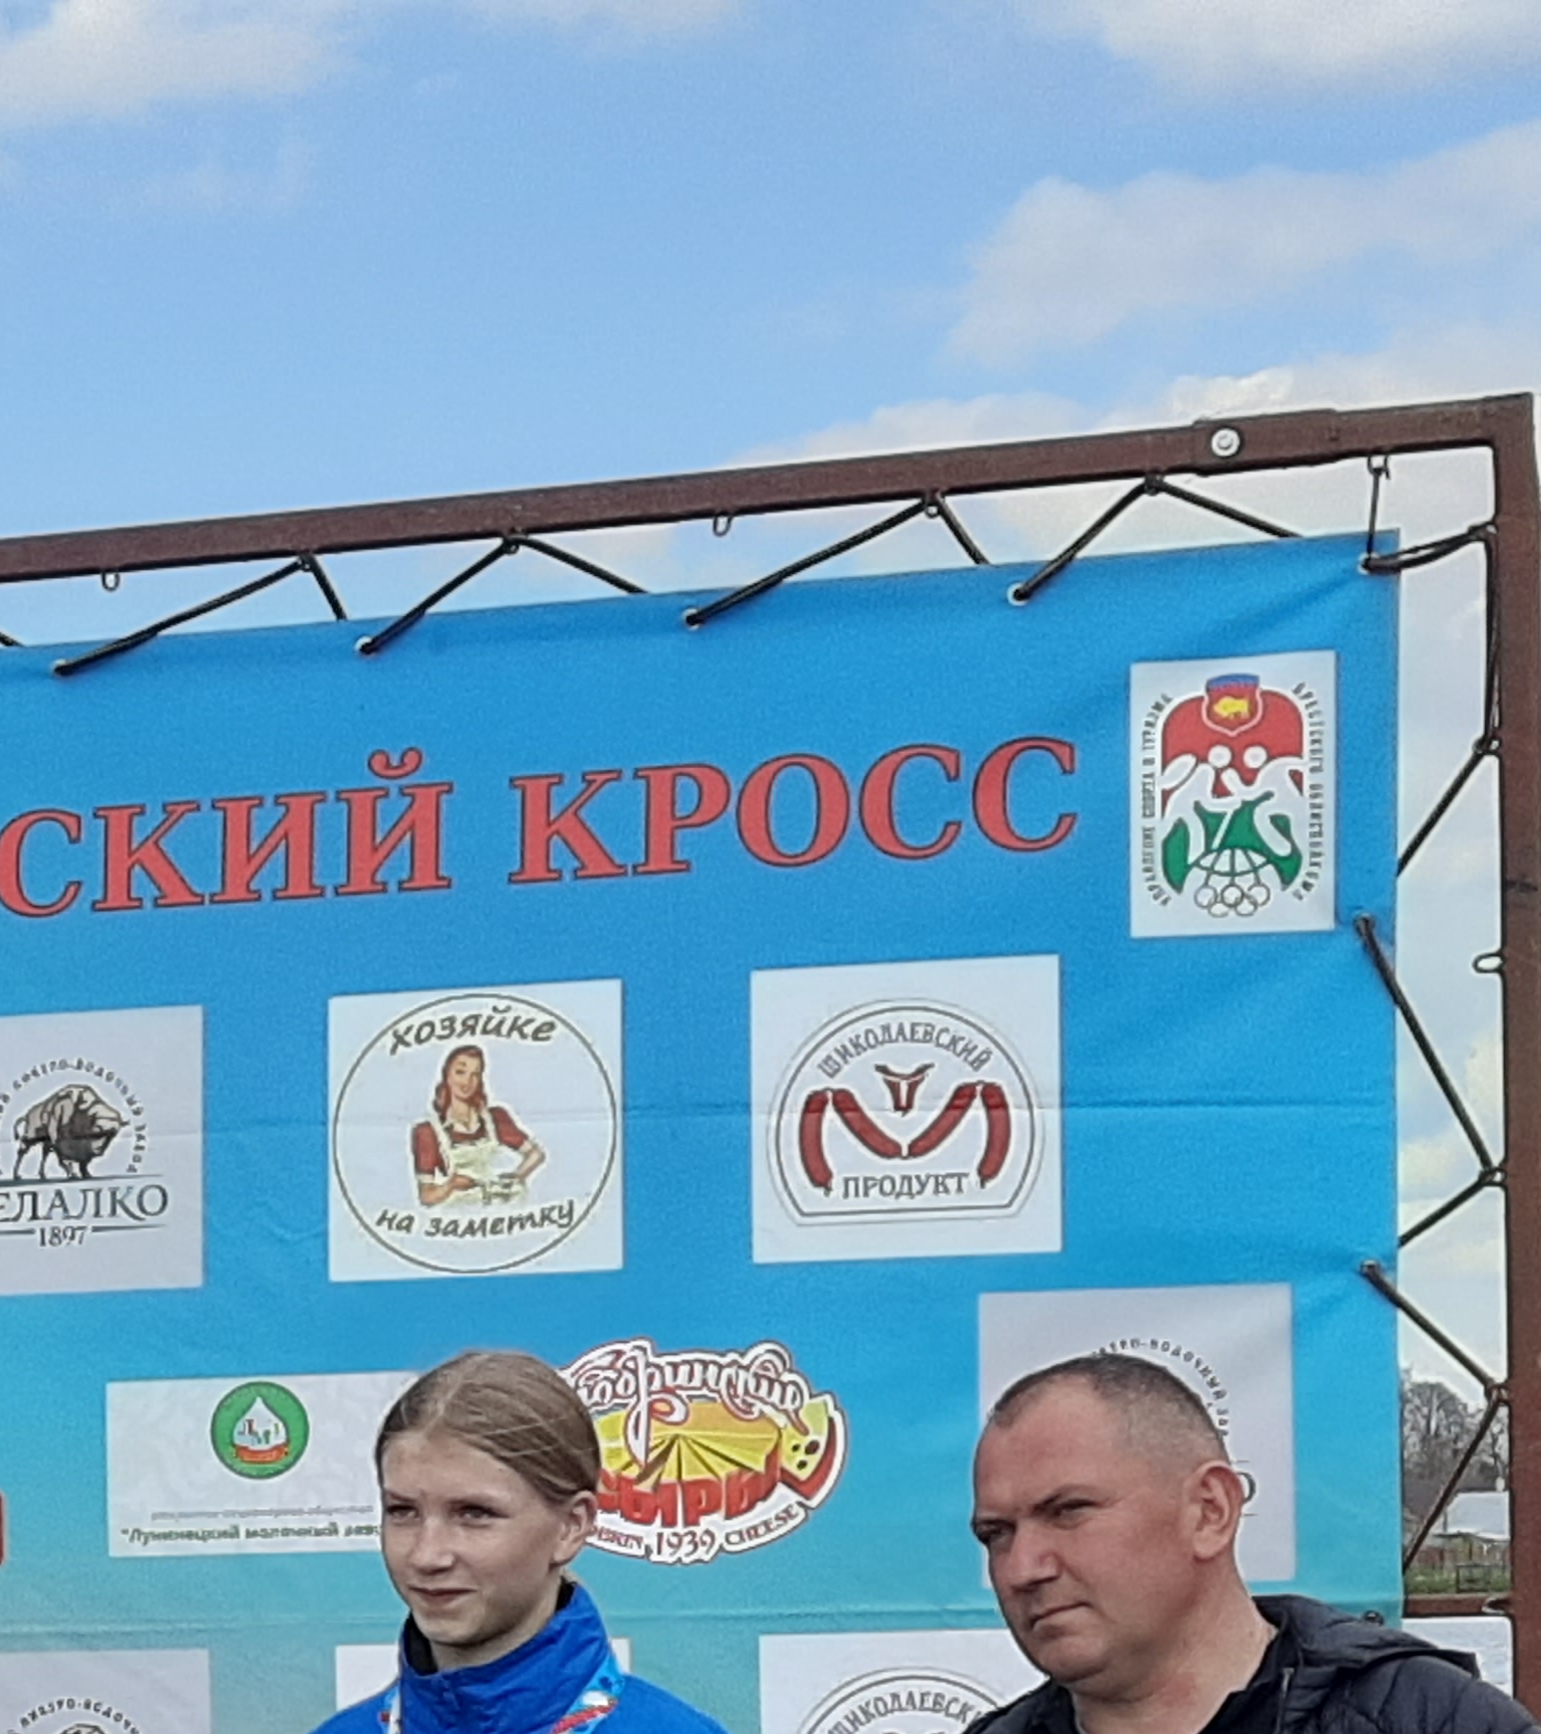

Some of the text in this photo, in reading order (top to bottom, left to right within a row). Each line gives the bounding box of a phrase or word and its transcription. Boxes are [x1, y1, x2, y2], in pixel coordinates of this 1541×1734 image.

[507, 736, 1078, 886] КРОСС
[842, 1172, 970, 1199] ПРОДУКТ
[39, 1225, 88, 1247] 1897
[656, 1530, 716, 1556] 1939
